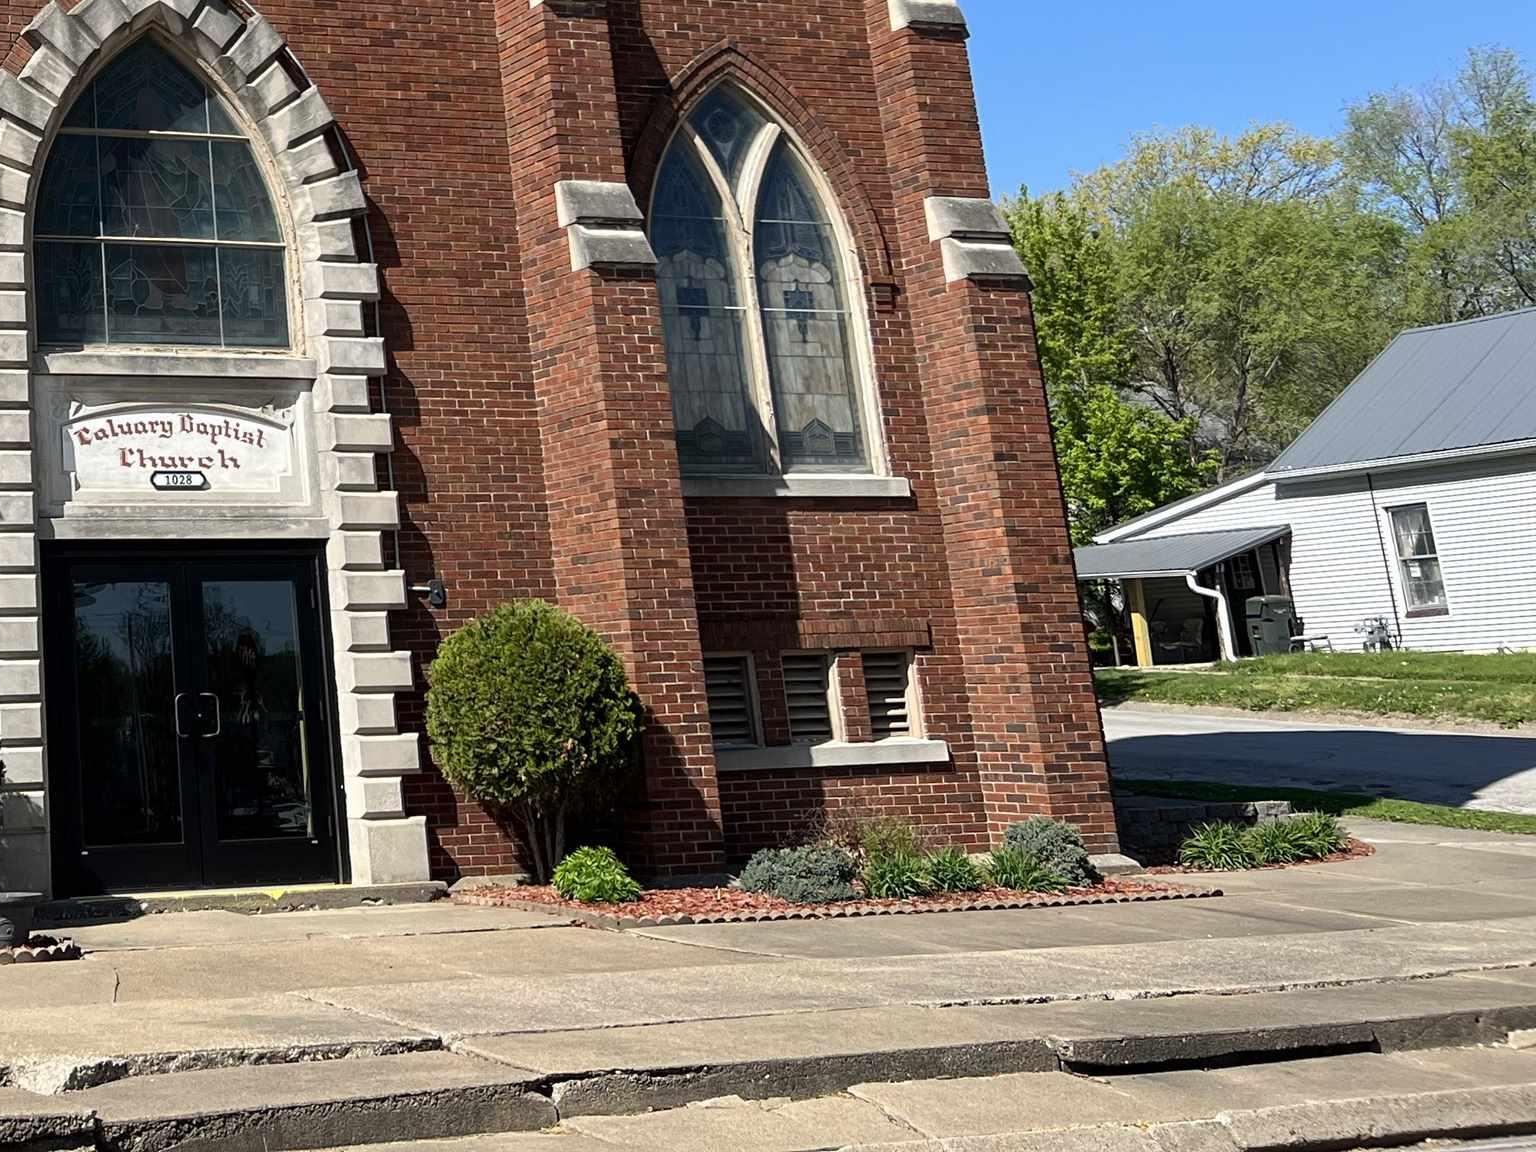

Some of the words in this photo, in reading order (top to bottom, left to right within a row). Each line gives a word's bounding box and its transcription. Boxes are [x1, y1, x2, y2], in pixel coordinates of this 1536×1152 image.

[179, 414, 266, 448] Baptist
[119, 447, 241, 469] Church
[165, 475, 193, 486] 1028
